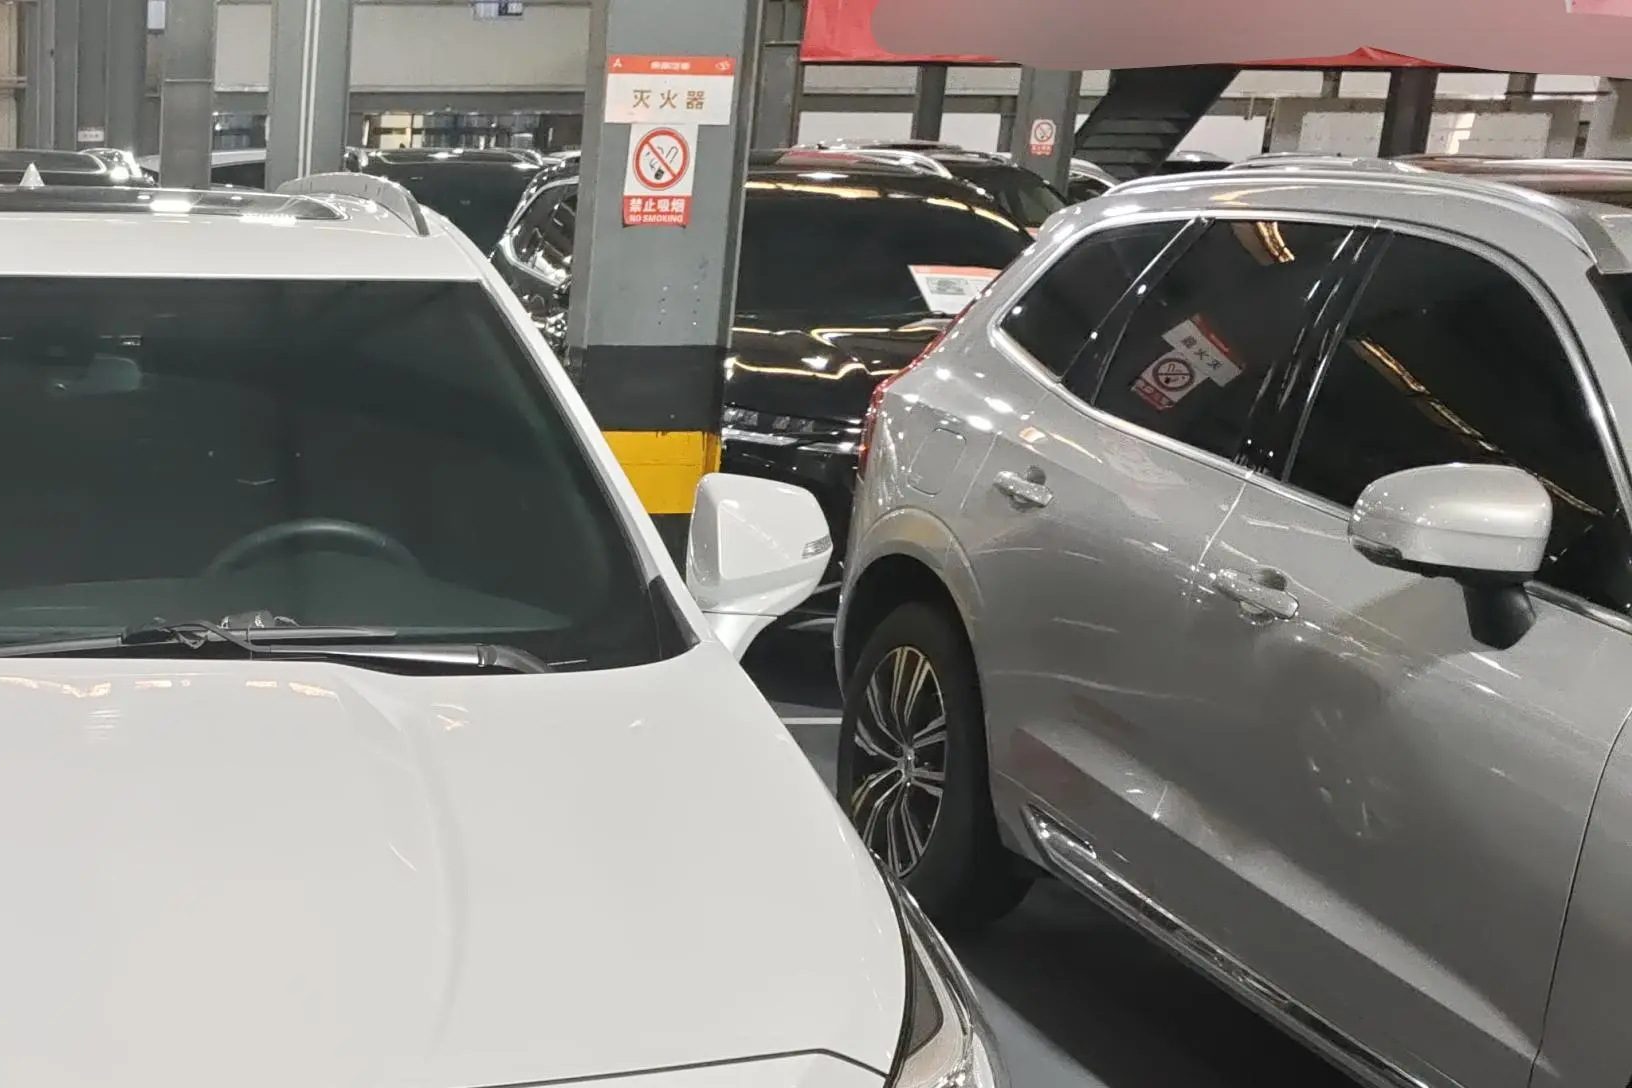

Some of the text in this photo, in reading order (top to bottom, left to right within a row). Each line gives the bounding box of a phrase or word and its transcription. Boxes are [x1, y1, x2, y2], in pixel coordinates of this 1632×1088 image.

[632, 89, 705, 110] 灭火器
[629, 198, 686, 213] 禁止吸烟
[629, 214, 684, 223] NO SMOKING
